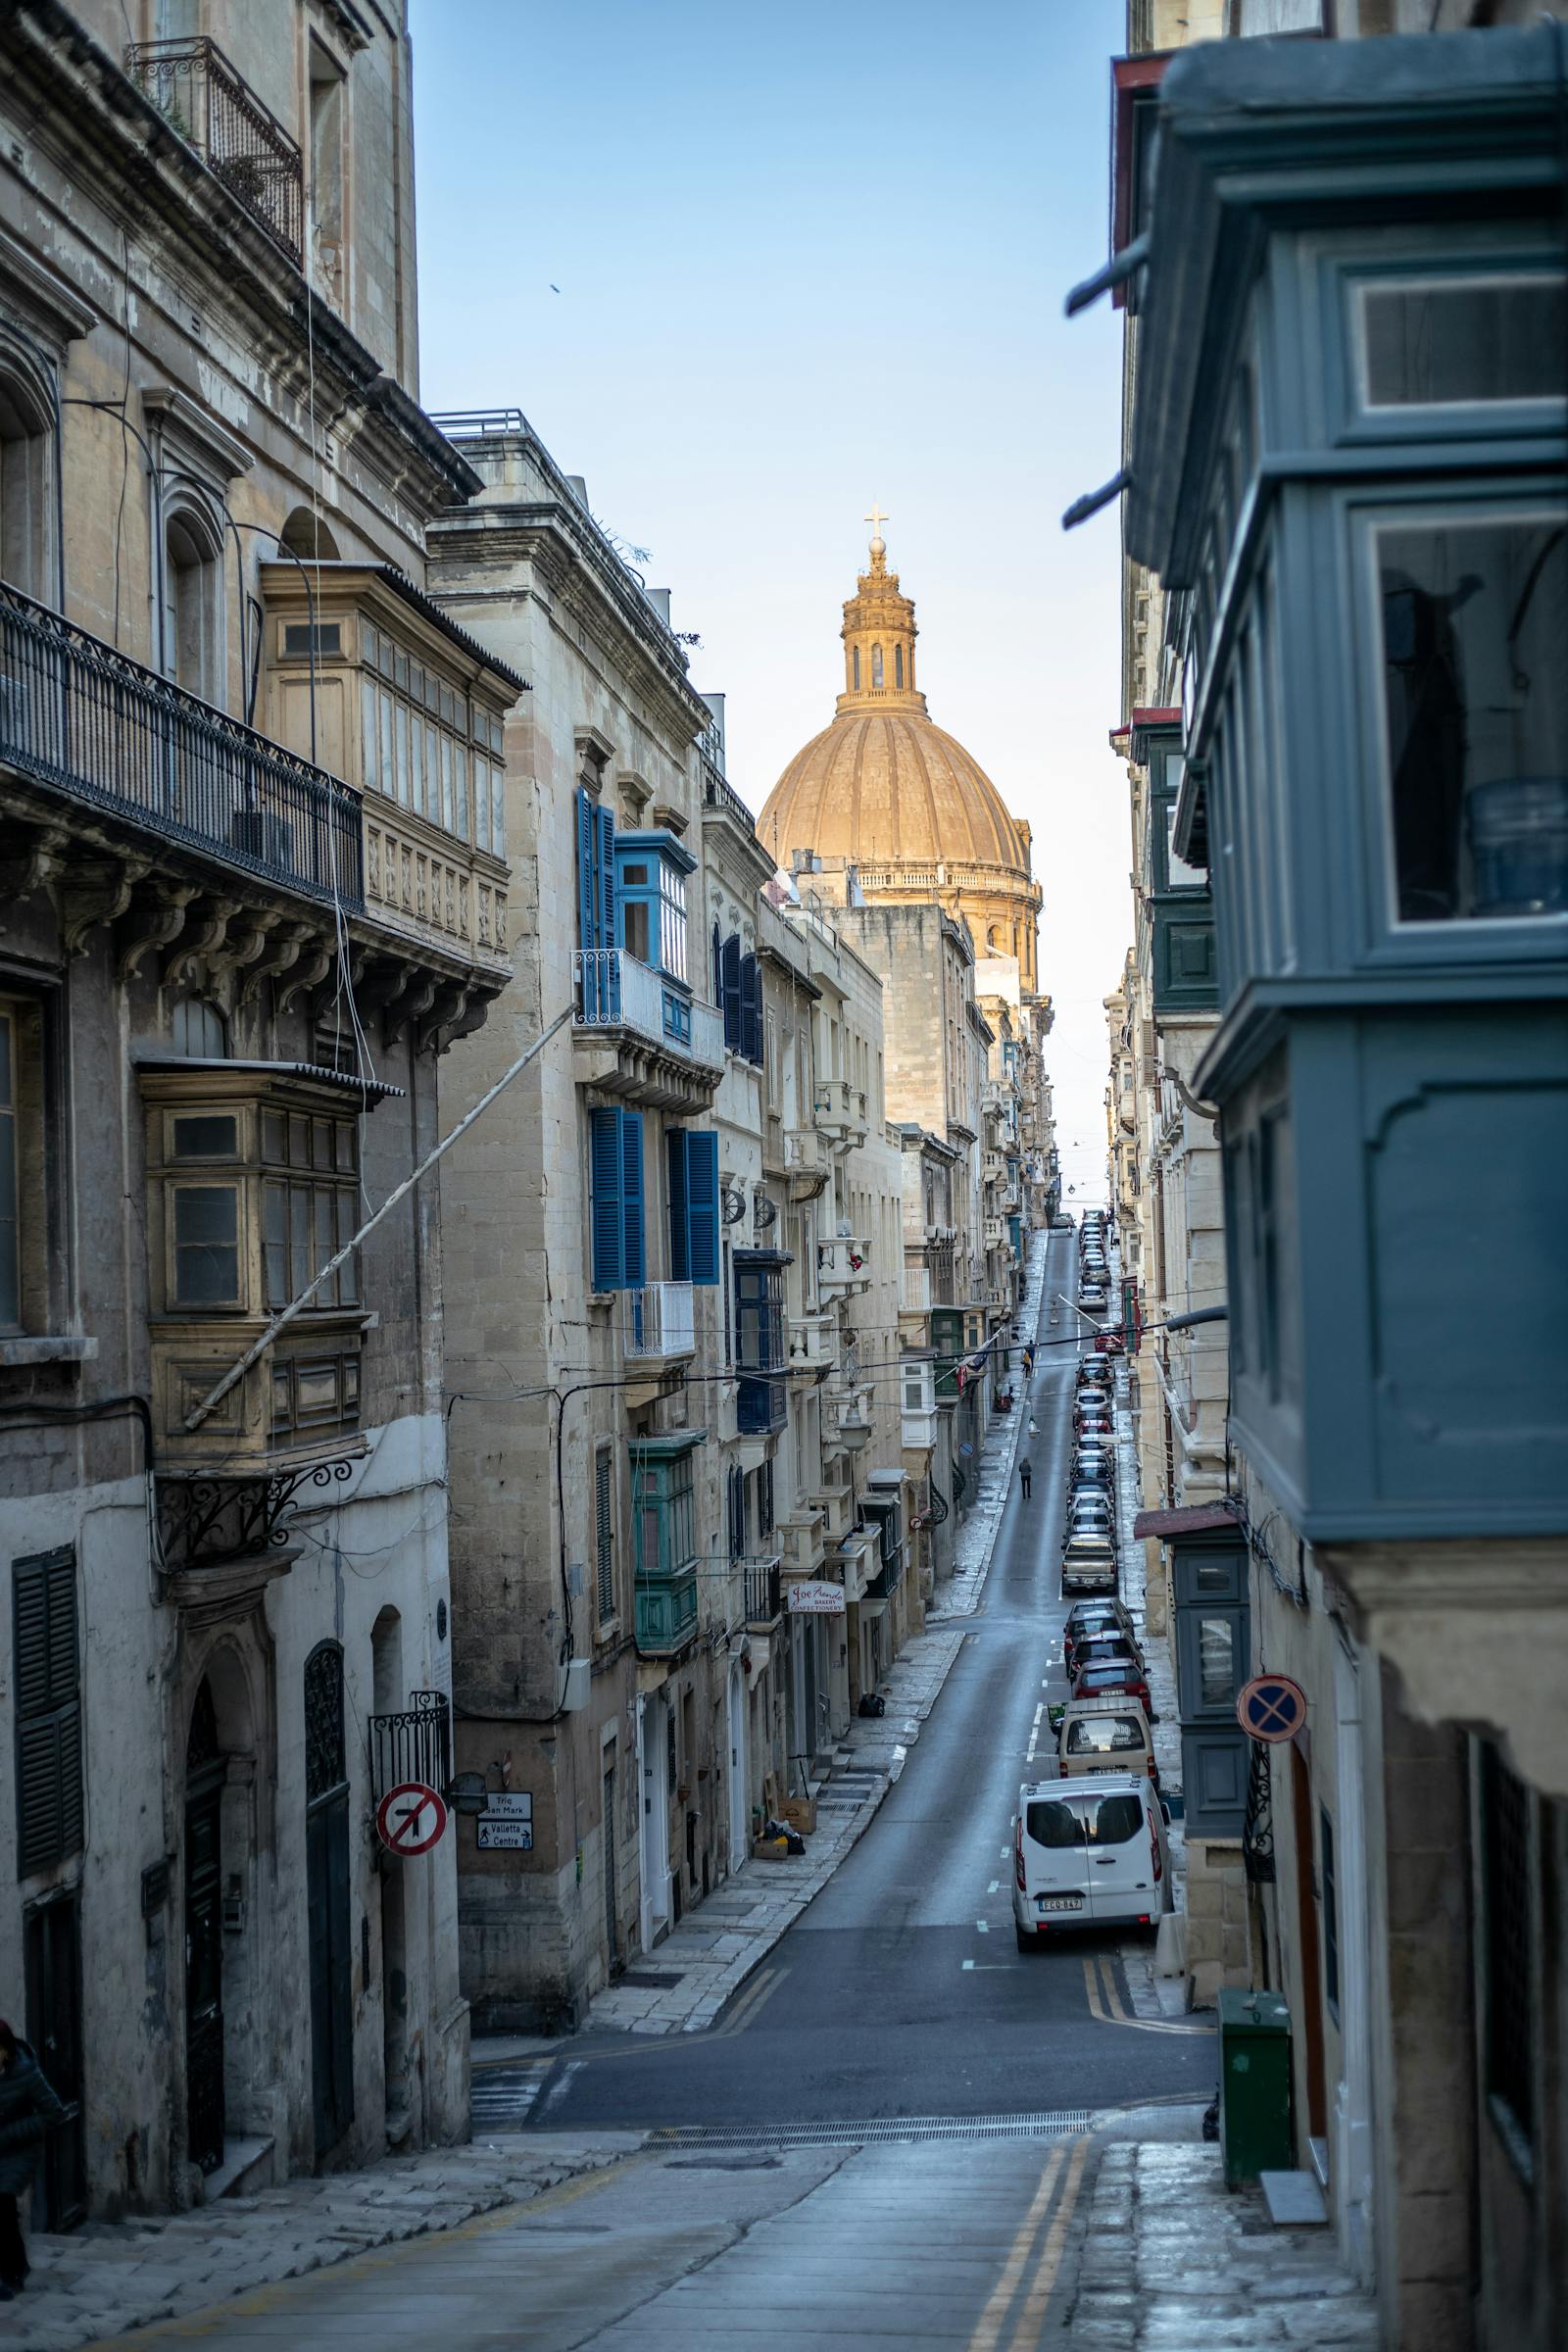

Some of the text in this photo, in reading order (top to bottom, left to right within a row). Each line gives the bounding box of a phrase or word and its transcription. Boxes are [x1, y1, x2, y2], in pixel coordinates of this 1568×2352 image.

[793, 1586, 843, 1606] Joe Frendo
[491, 1824, 520, 1834] Valletta
[493, 1837, 518, 1846] Centre
